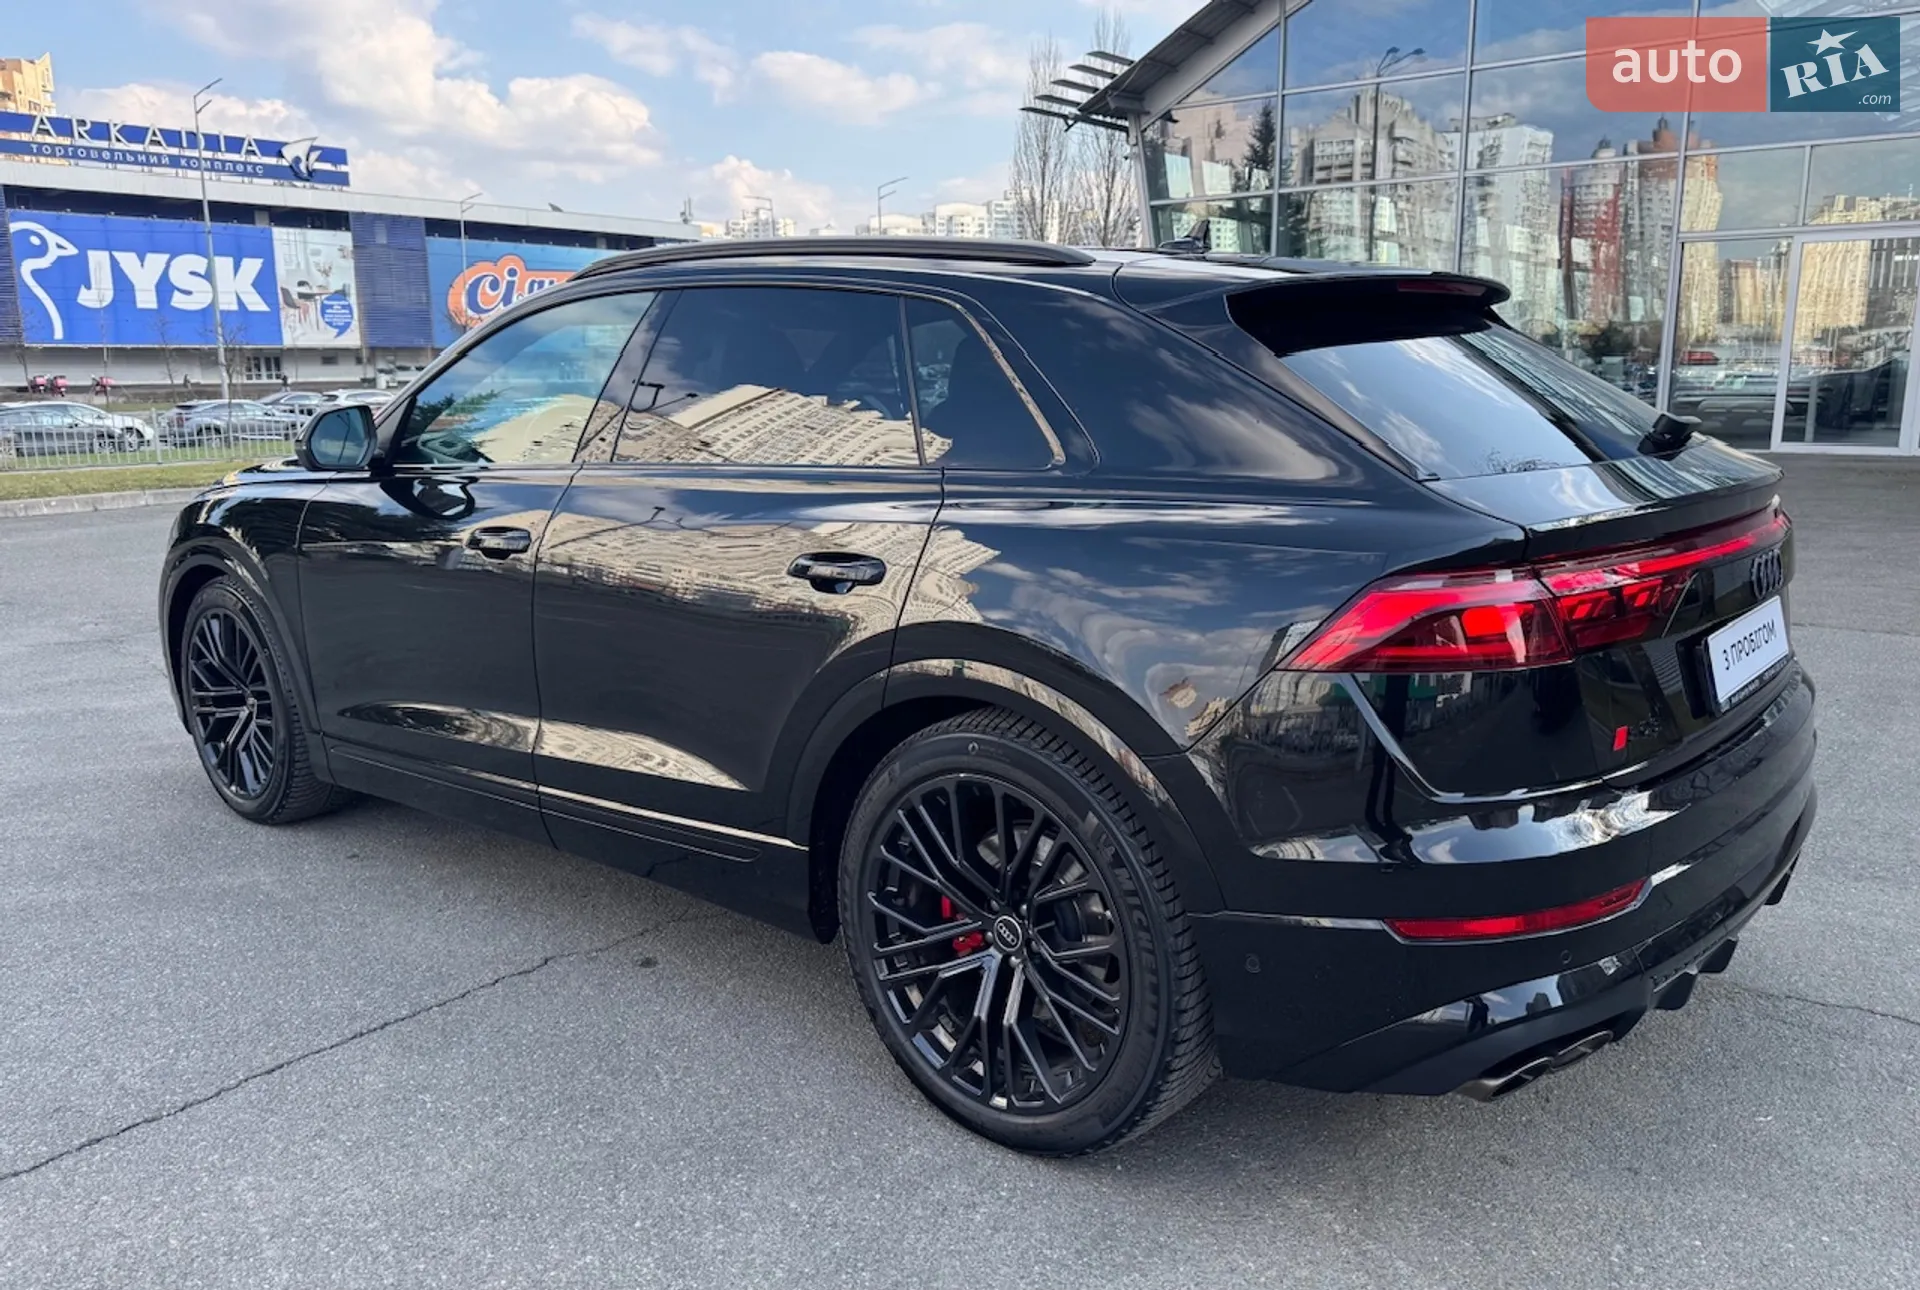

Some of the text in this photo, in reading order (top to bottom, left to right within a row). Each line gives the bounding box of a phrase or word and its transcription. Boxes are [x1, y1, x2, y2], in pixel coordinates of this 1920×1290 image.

[30, 143, 265, 174] торговельний комплекс
[31, 113, 262, 159] ARKADIA
[76, 249, 271, 312] JYSK
[1730, 618, 1777, 665] ПРОБІГОМ
